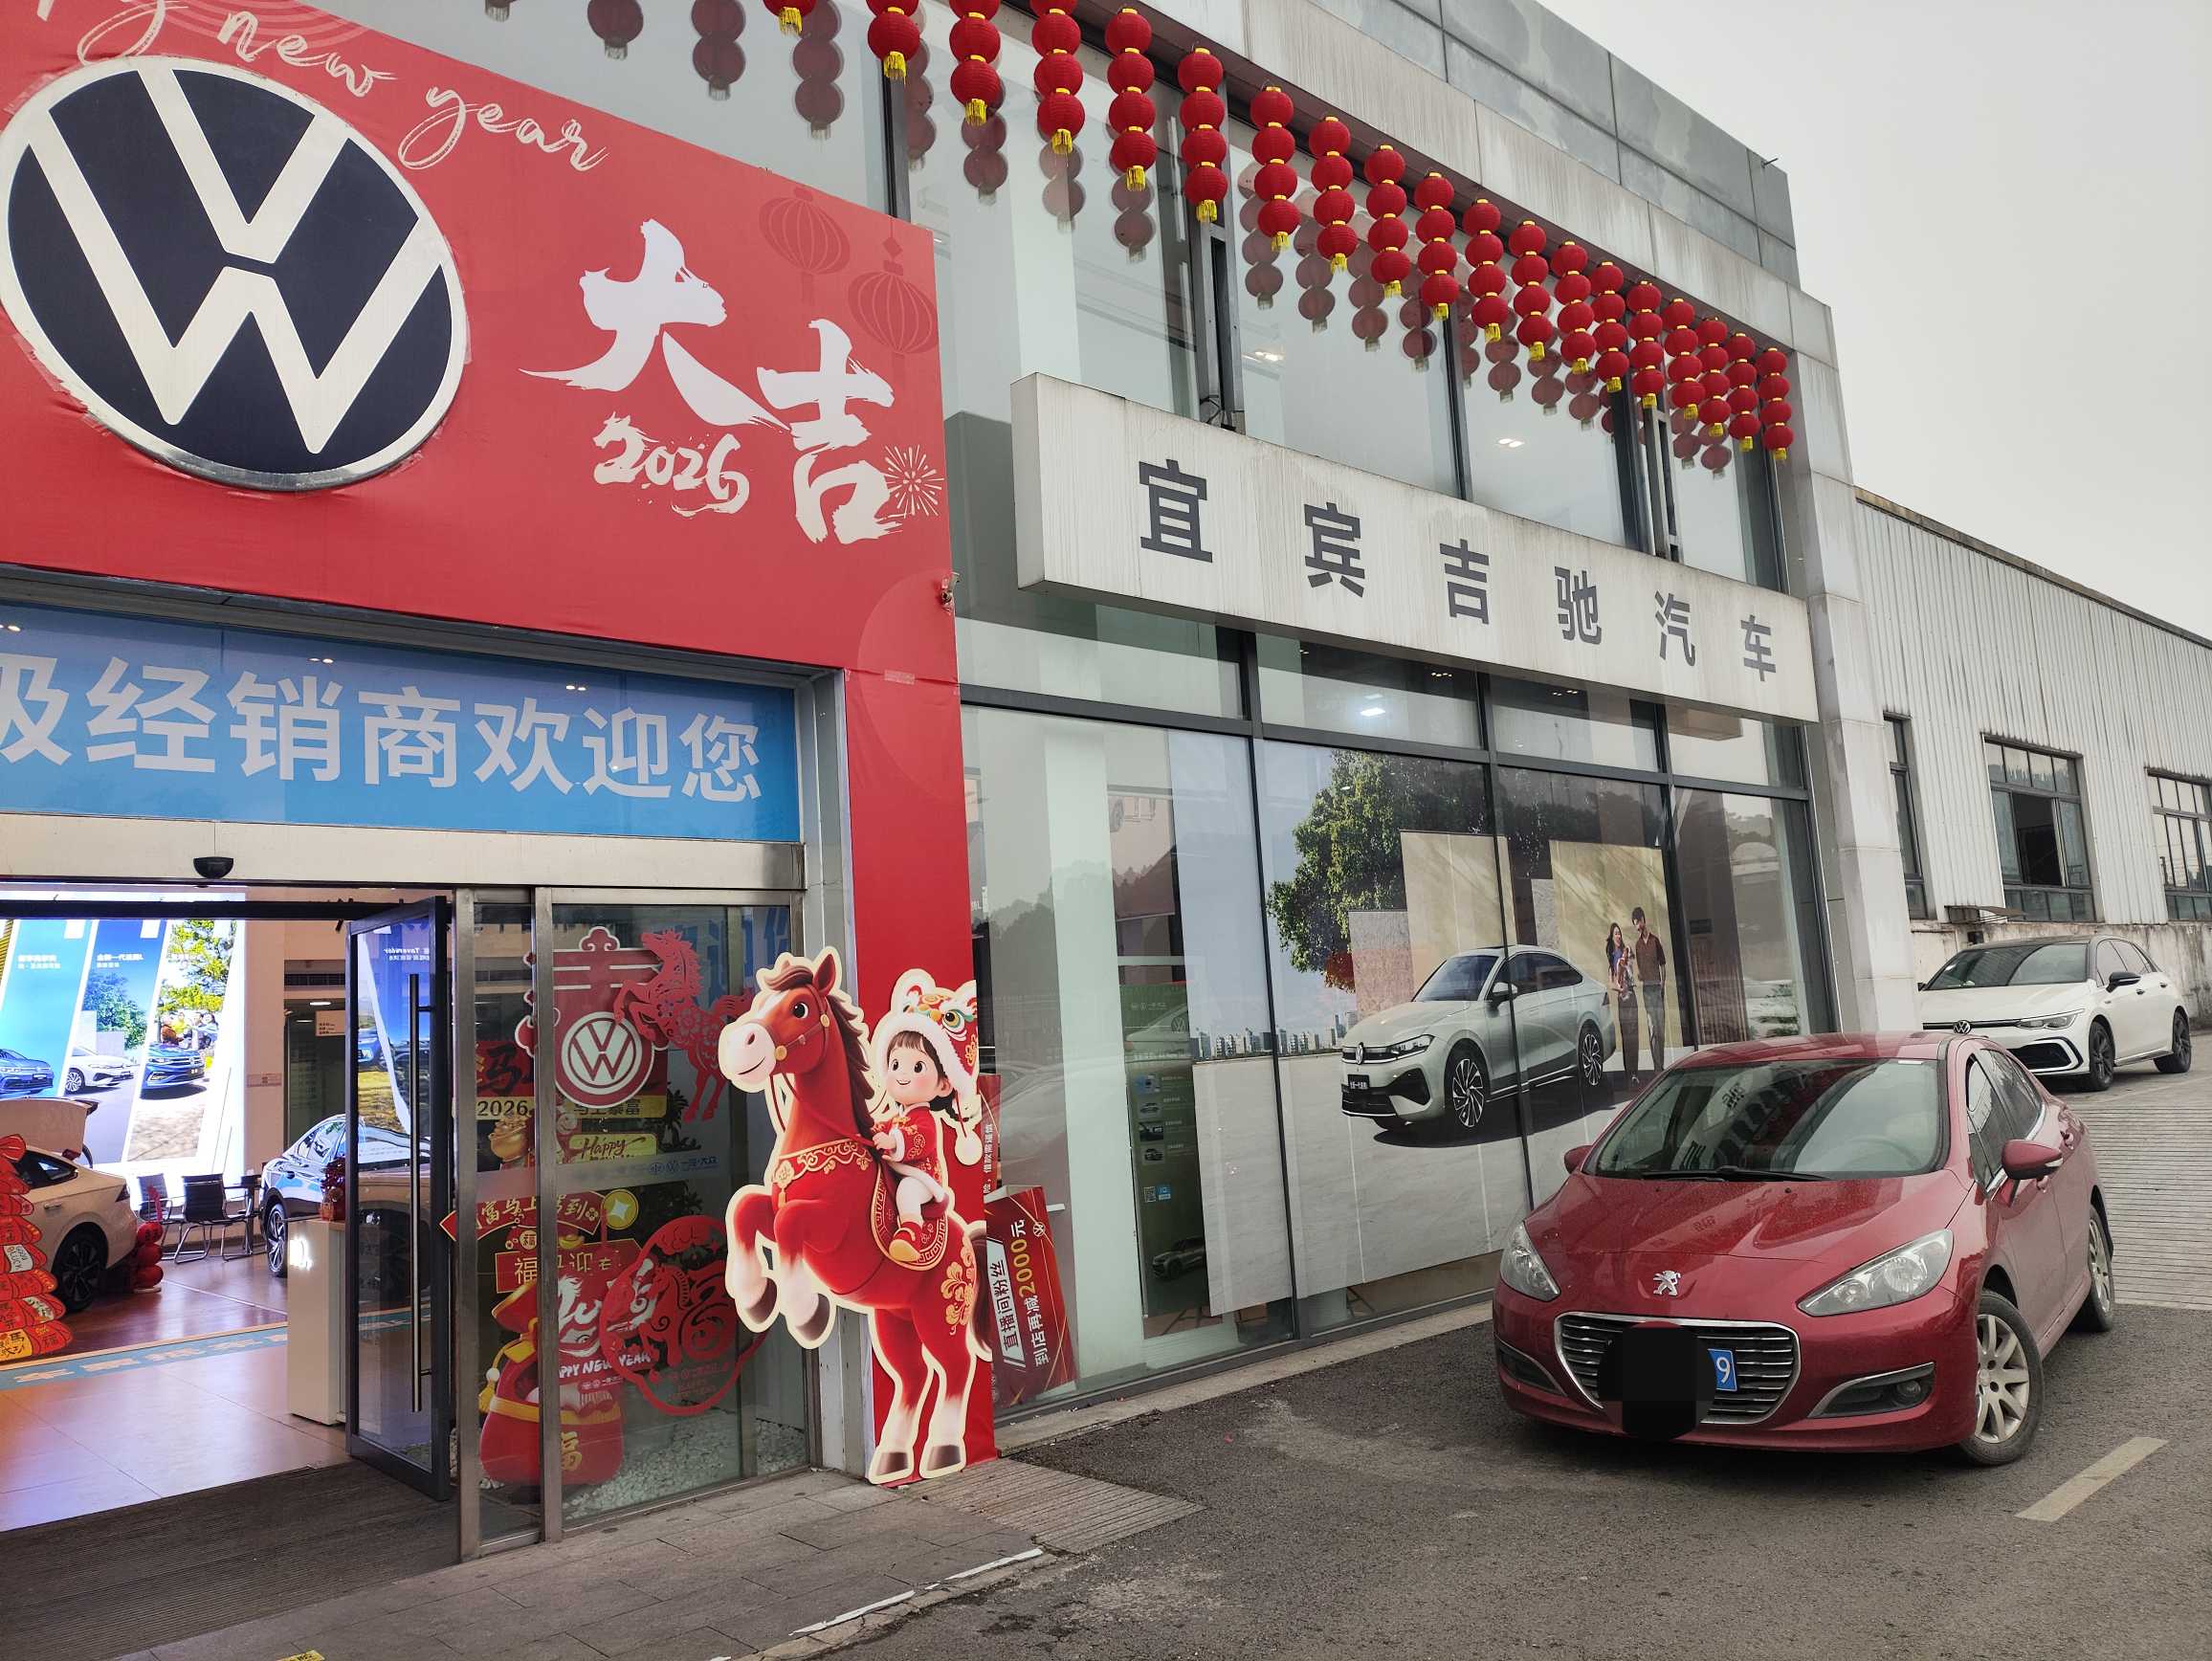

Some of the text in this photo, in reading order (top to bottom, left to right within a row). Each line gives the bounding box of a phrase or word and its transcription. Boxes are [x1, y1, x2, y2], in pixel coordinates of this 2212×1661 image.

[218, 10, 397, 98] new
[399, 83, 609, 170] year
[519, 218, 903, 544] 大吉
[592, 411, 750, 518] 2026
[1139, 458, 1777, 682] 宜宾吉驰汽车
[477, 1099, 528, 1117] 2026
[989, 1259, 1019, 1349] 直播间粉丝
[1010, 1219, 1050, 1367] 到店再减2000元
[1716, 1357, 1730, 1384] 9
